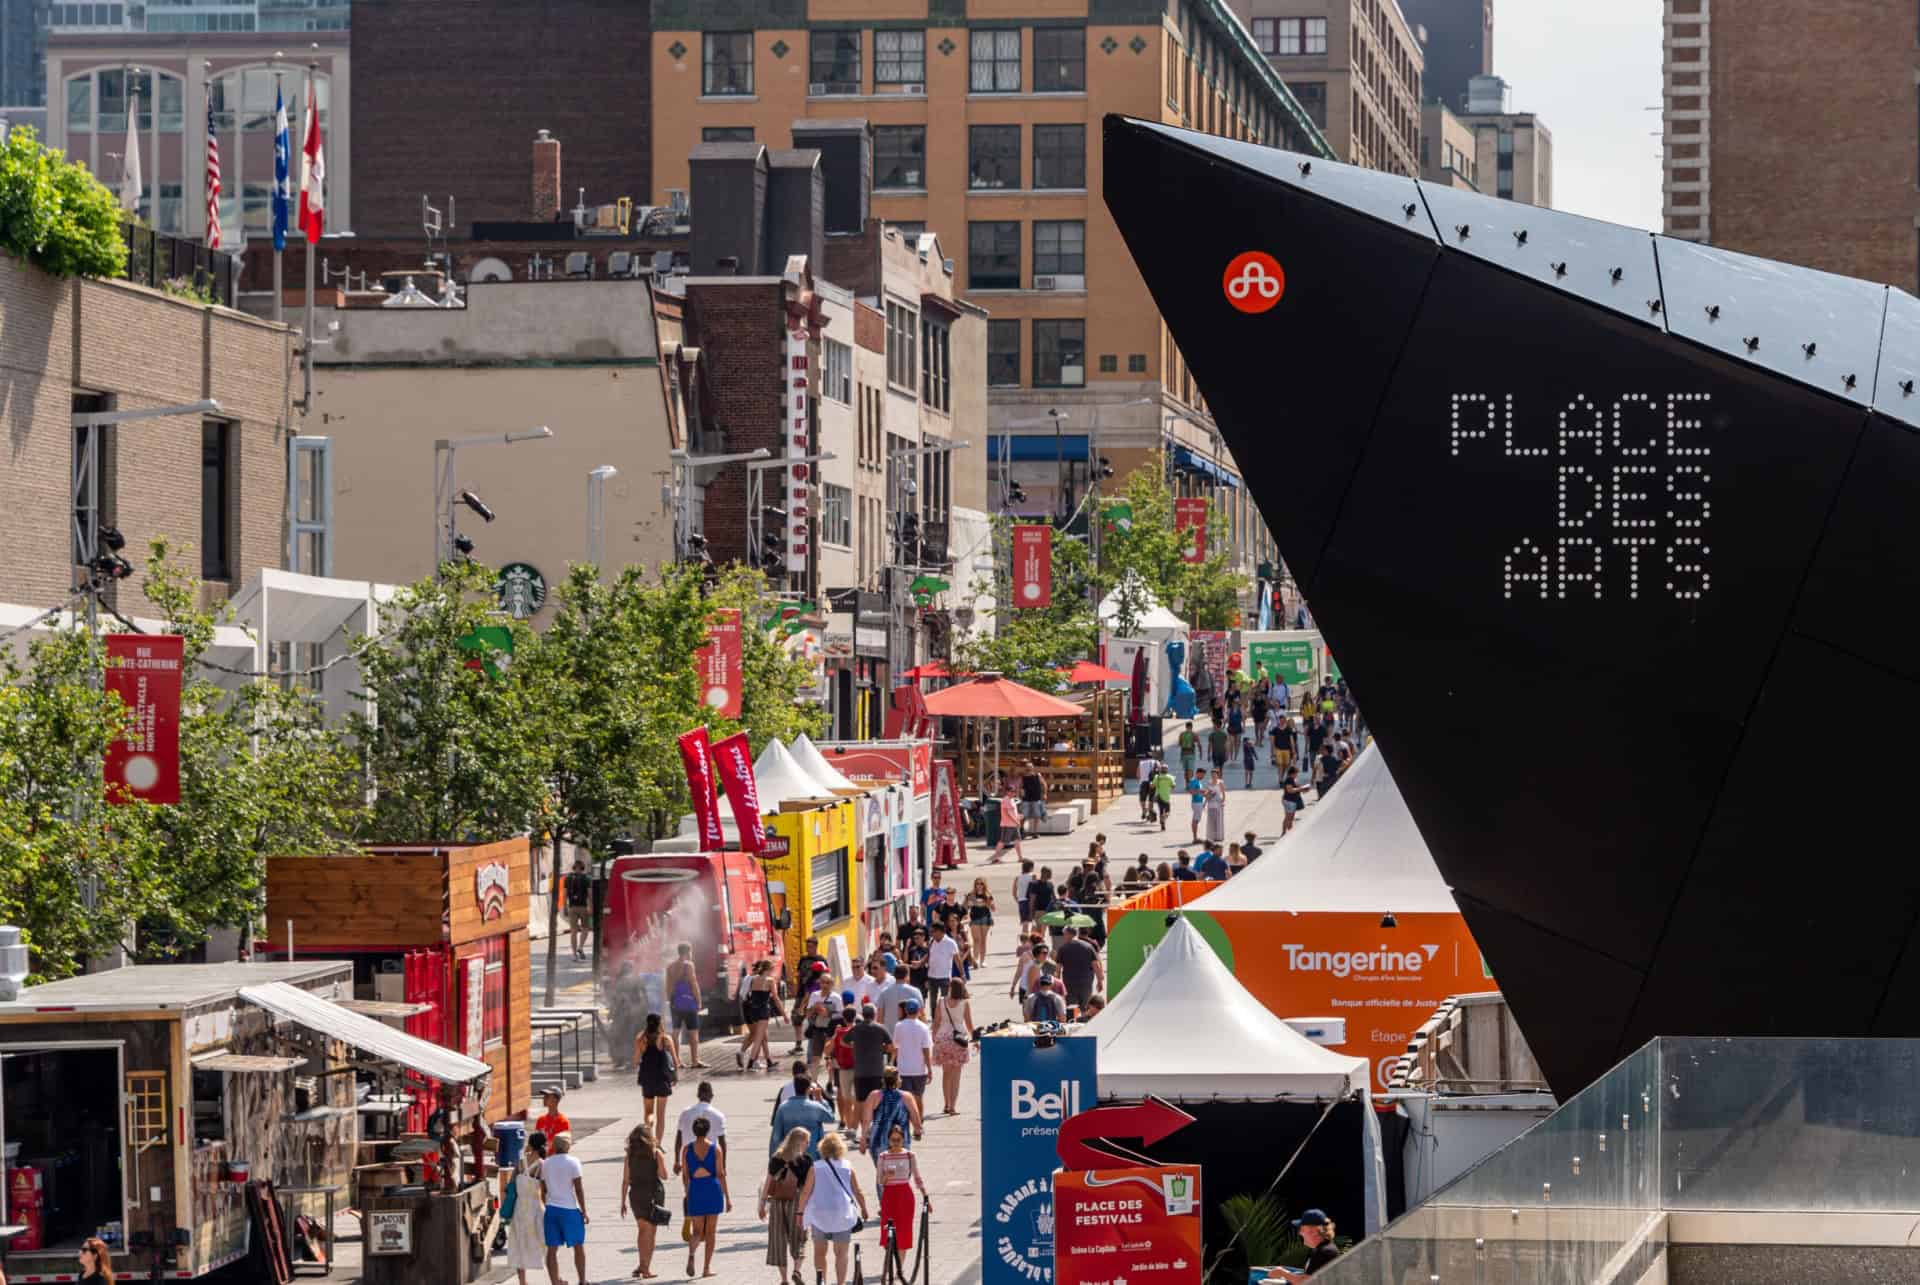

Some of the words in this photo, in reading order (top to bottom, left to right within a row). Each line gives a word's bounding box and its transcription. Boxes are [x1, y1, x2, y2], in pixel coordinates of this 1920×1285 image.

[1452, 393, 1711, 456] PLACE
[1559, 466, 1711, 528] DES
[1504, 538, 1711, 599] ARTS
[730, 746, 758, 810] Hortons
[767, 839, 788, 852] EMAN
[1282, 944, 1423, 977] Tangerine
[1331, 998, 1363, 1008] Banque
[1364, 998, 1402, 1007] officielle
[1402, 998, 1413, 1006] de
[1416, 999, 1438, 1007] Juste
[1371, 1028, 1406, 1044] Étape
[1011, 1080, 1080, 1120] Bell
[1022, 1125, 1060, 1138] présen
[1075, 1200, 1115, 1212] PLACE
[1118, 1200, 1142, 1210] DES
[374, 1215, 406, 1226] BACON
[1075, 1214, 1142, 1226] FESTIVALS
